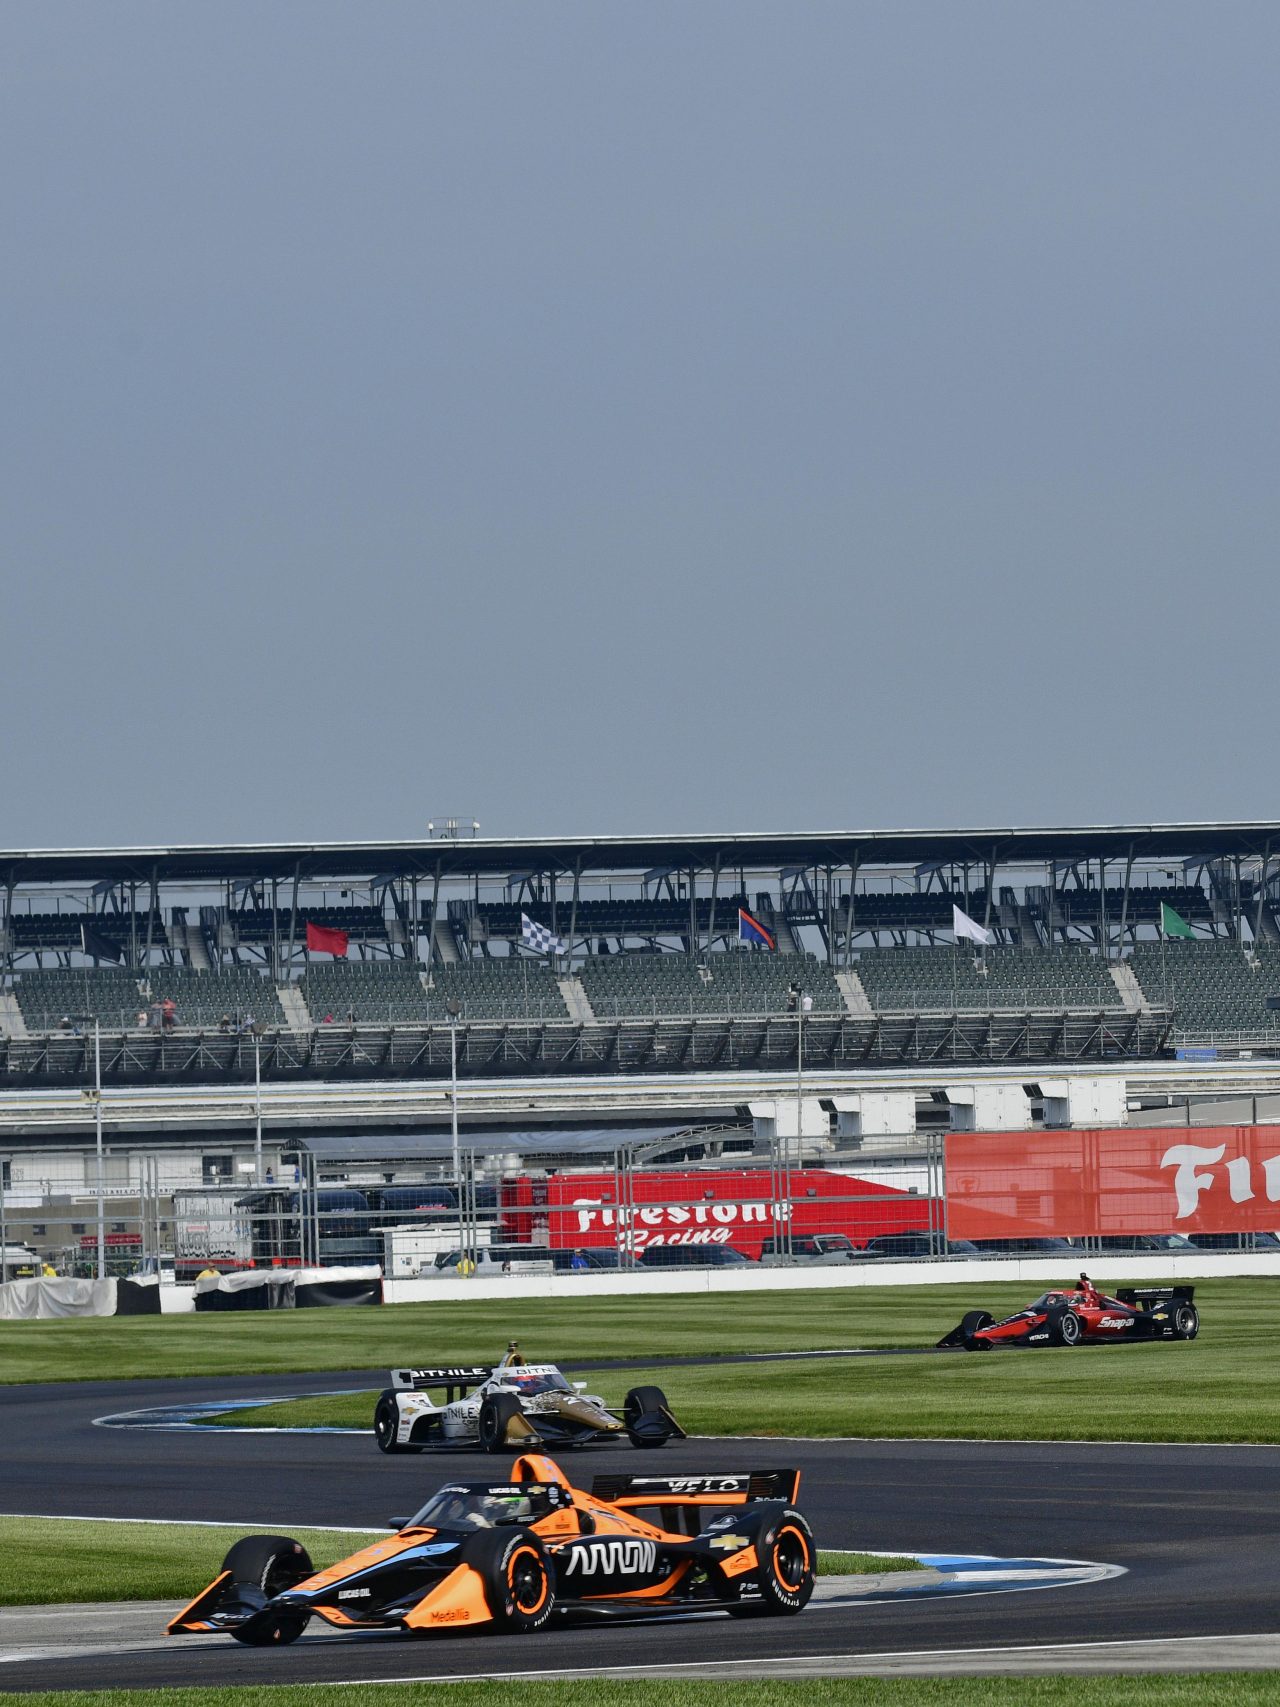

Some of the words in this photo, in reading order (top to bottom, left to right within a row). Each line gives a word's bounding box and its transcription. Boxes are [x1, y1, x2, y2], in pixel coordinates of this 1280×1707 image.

[572, 1198, 793, 1233] Firestone
[615, 1227, 733, 1253] Racing
[1097, 1316, 1135, 1329] Snap-on
[668, 1480, 740, 1492] VELO
[566, 1541, 656, 1575] ARROW
[431, 1609, 470, 1623] Medallia
